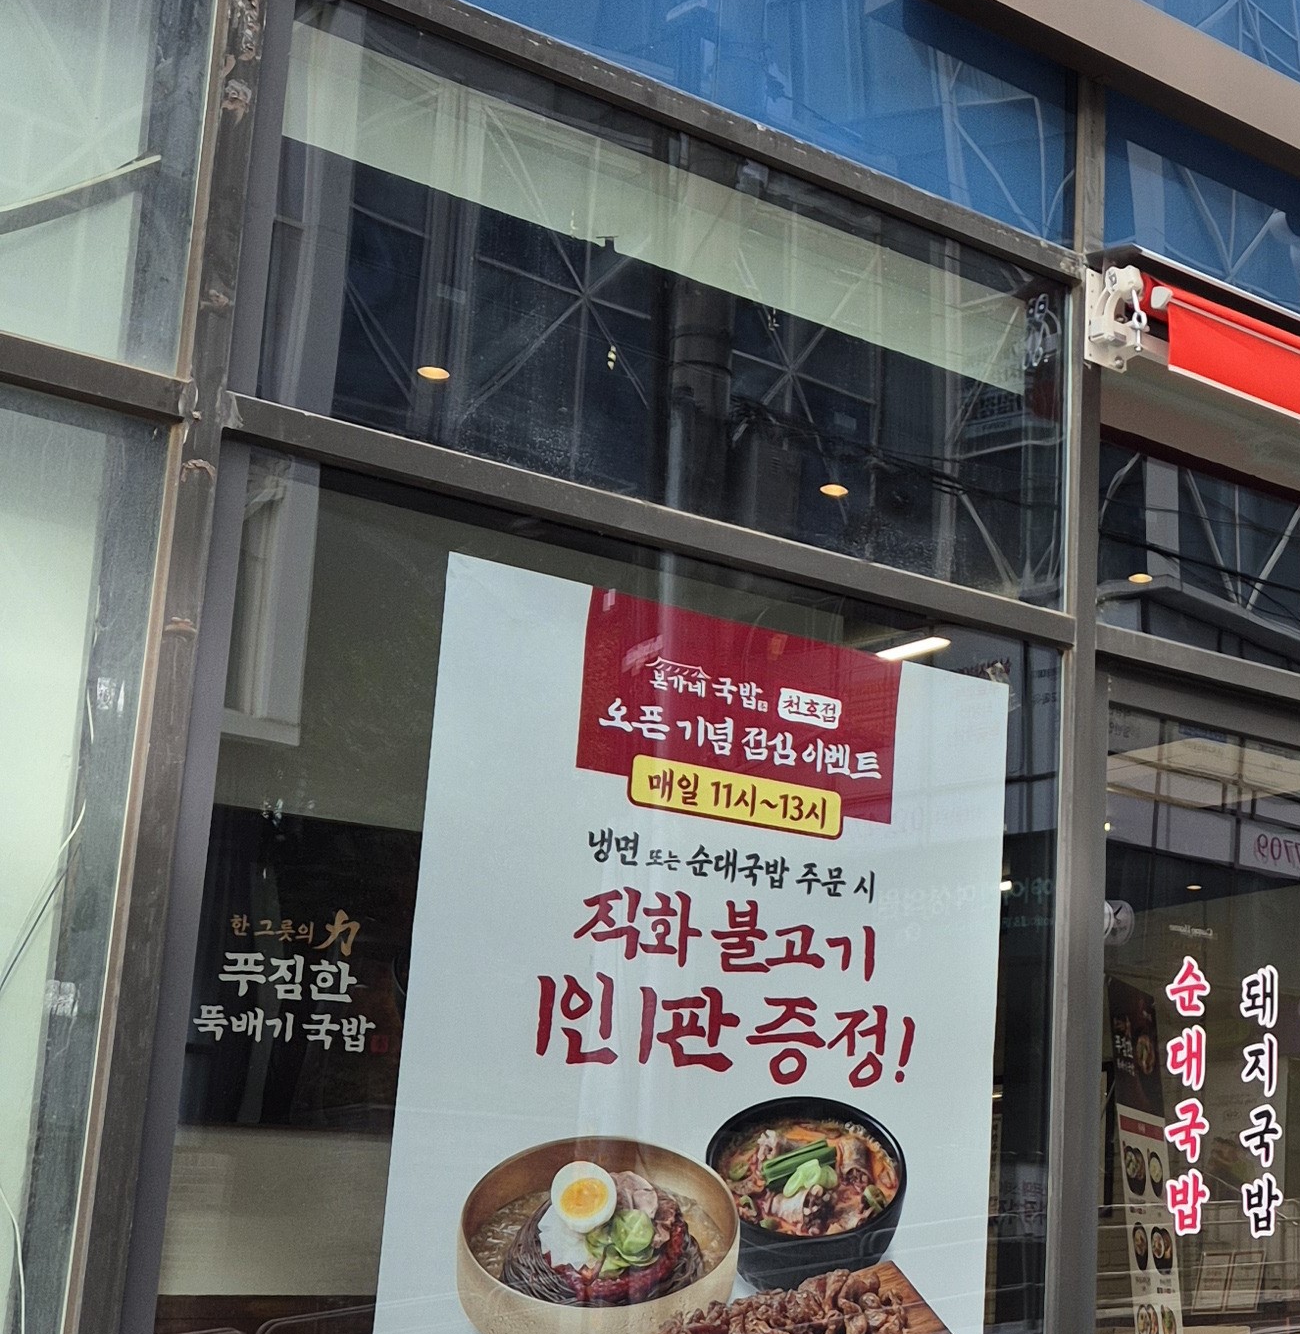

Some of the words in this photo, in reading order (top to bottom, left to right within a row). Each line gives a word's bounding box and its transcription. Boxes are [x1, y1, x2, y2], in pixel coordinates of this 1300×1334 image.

[648, 668, 707, 698] 본가네
[711, 676, 764, 712] 국밥
[781, 693, 838, 724] 천호점
[598, 697, 671, 741] 오픈
[675, 715, 734, 757] 기념
[740, 725, 797, 767] 점심
[801, 737, 883, 780] 이벤트
[647, 766, 700, 808] 매일
[709, 779, 828, 830] 11시~13시
[588, 827, 640, 867] 냉면
[645, 849, 682, 871] 또는
[685, 843, 790, 890] 순대국밥
[795, 863, 847, 898] 주문
[853, 870, 877, 904] 시
[230, 914, 251, 937] 한
[254, 919, 315, 945] 그릇의
[573, 885, 703, 969] 직화
[710, 899, 876, 983] 불고기
[218, 951, 358, 1003] 푸짐한
[192, 1004, 295, 1044] 뚝배기
[302, 1014, 377, 1054] 국밥
[535, 972, 621, 1066] 1인
[637, 985, 741, 1074] 1판
[745, 995, 918, 1091] 증정!
[1166, 956, 1210, 1236] 순대국밥
[1240, 966, 1281, 1238] 돼지국밥
